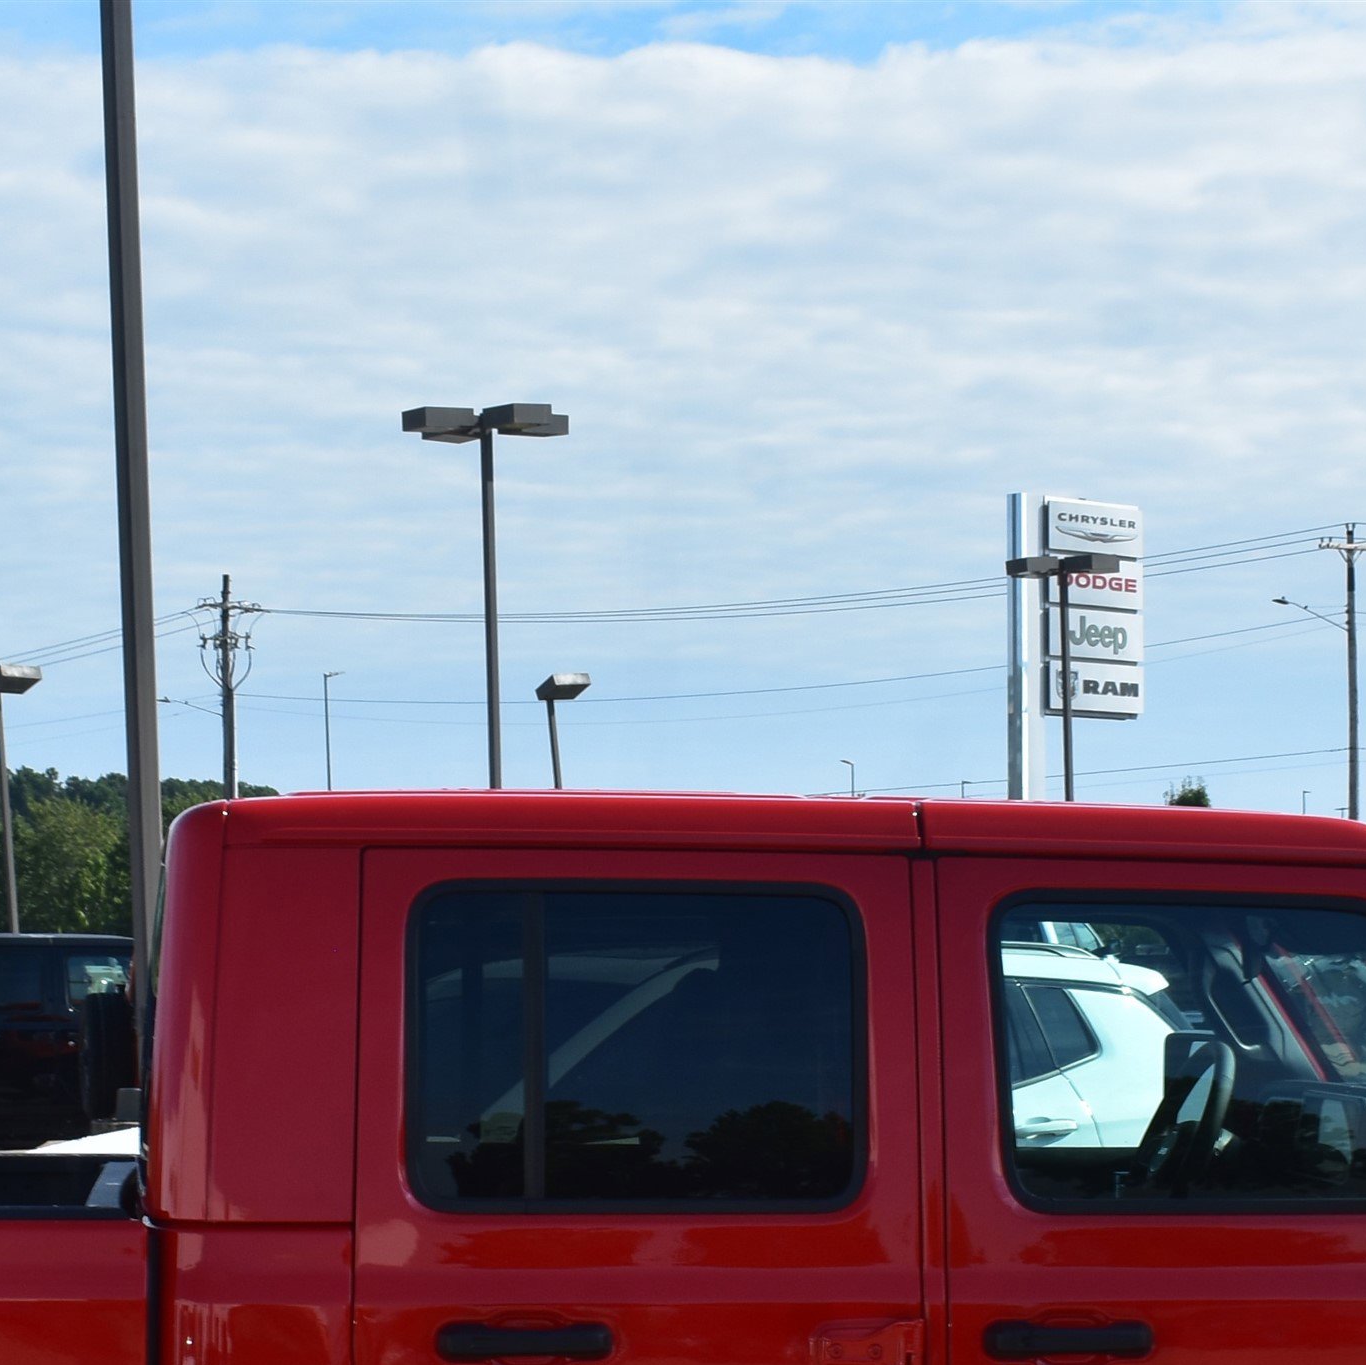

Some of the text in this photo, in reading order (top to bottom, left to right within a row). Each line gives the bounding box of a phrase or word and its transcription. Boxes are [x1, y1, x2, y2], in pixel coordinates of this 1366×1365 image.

[1057, 512, 1137, 530] CHRYSLER
[1069, 615, 1128, 655] Jeep
[1082, 679, 1140, 698] RAM
